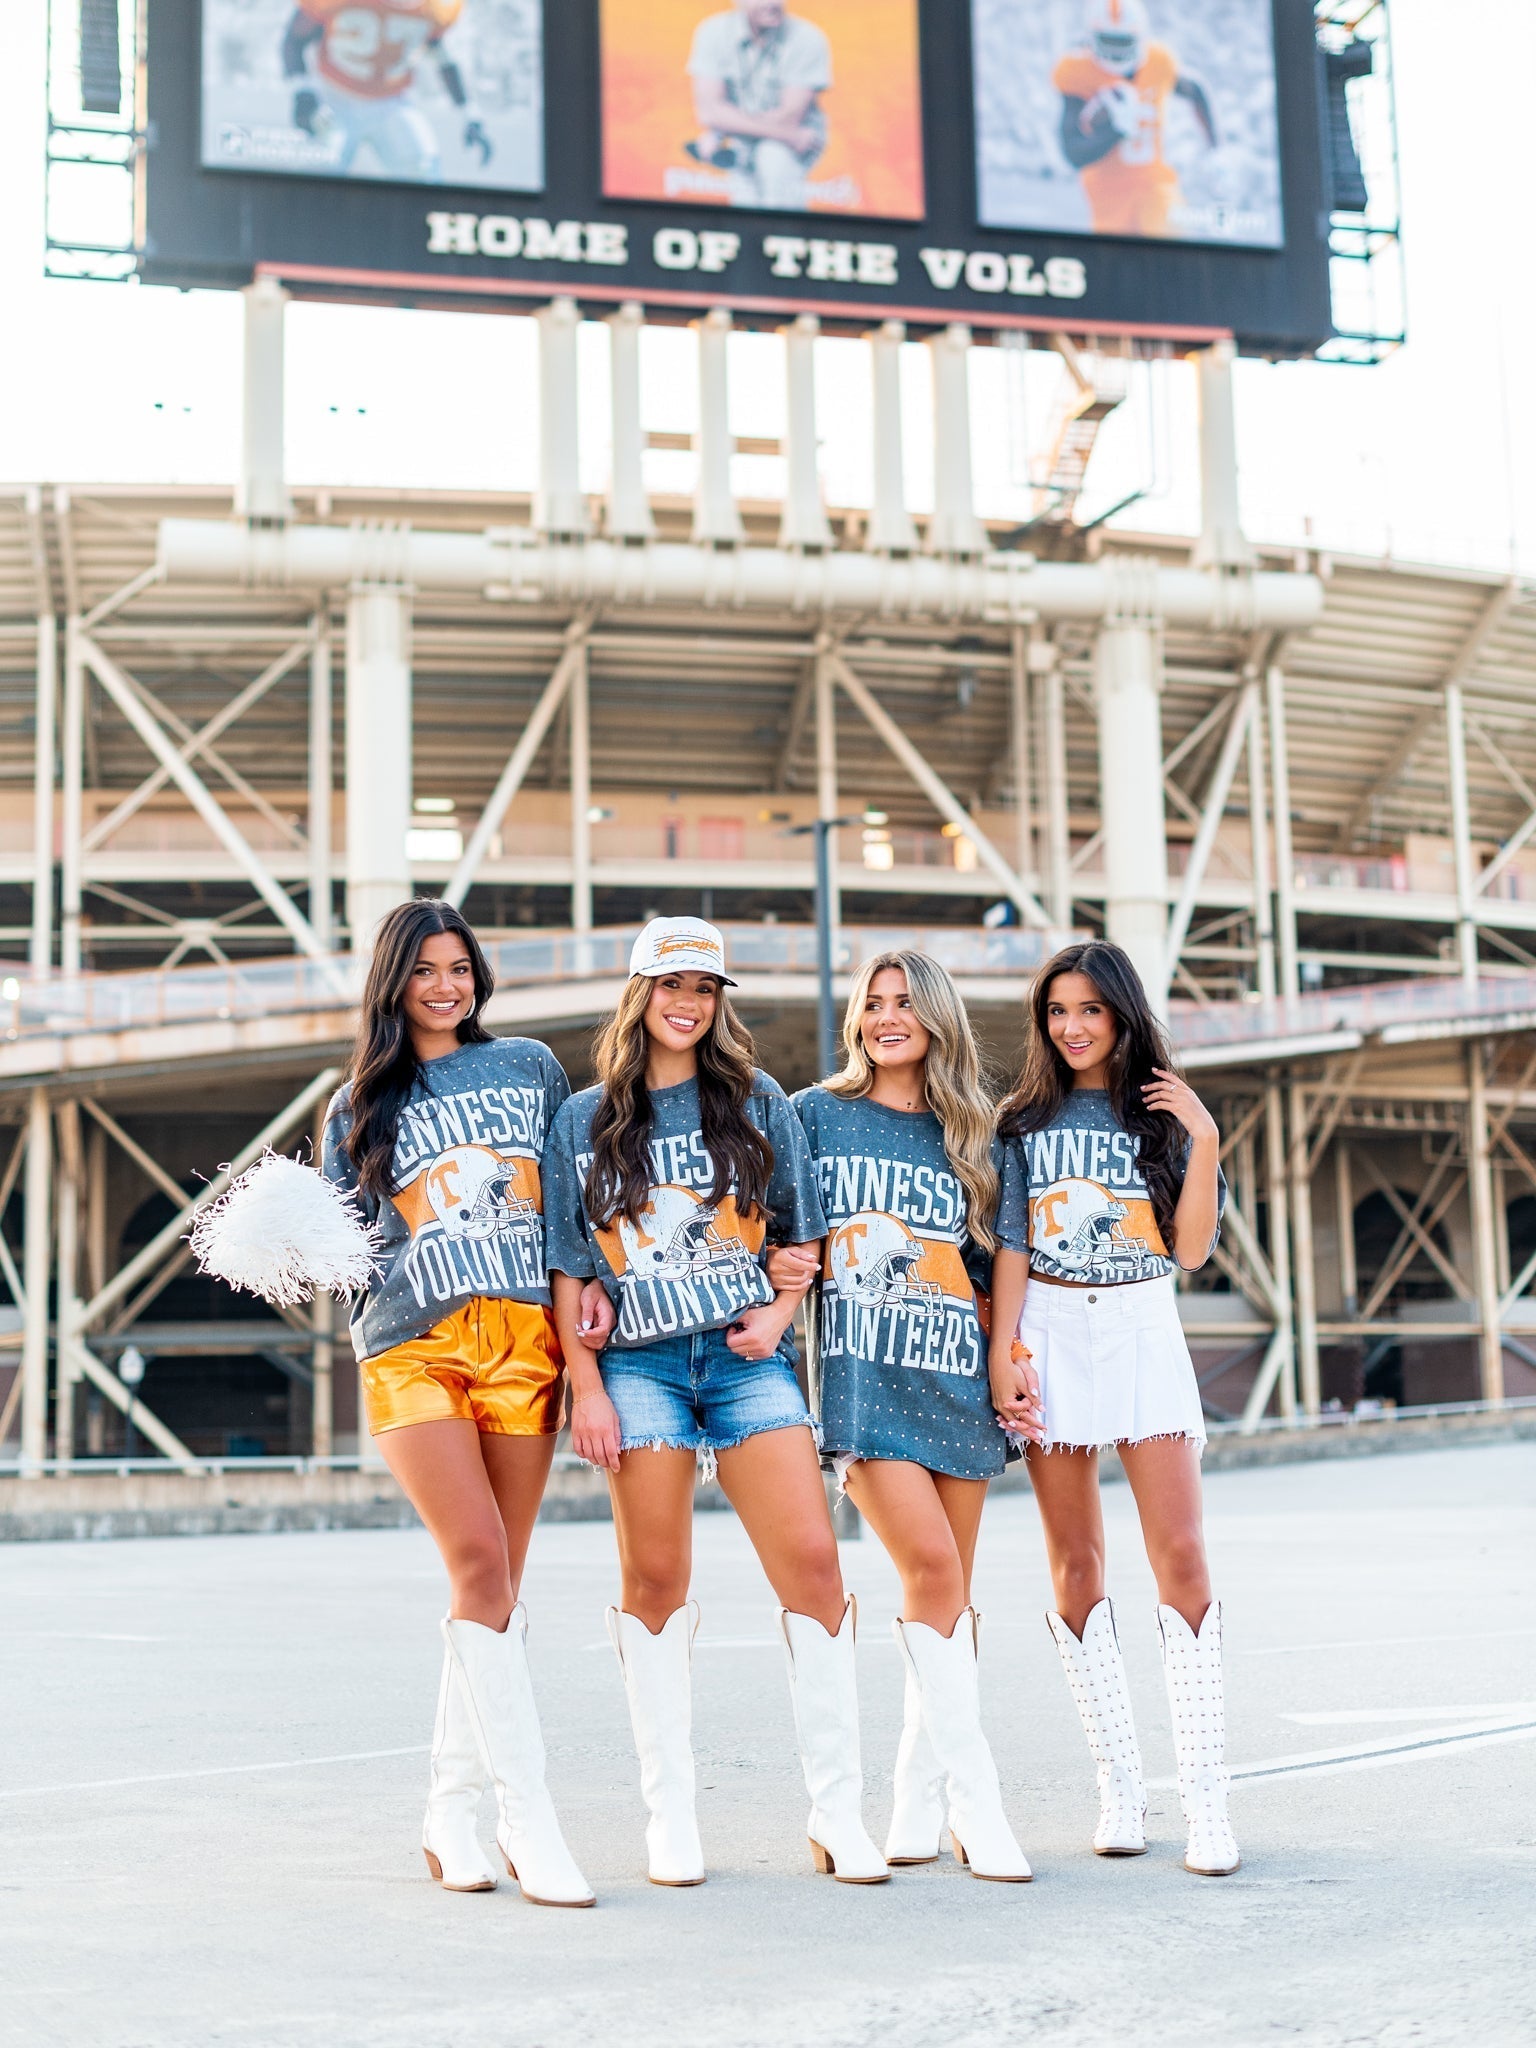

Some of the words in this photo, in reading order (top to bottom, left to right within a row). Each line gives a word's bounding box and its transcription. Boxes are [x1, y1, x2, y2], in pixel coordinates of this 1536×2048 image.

[427, 212, 628, 265] HOME
[653, 228, 740, 272] OF
[763, 235, 898, 285] THE
[919, 248, 1087, 299] VOLS
[430, 1160, 463, 1209] T
[1036, 1190, 1069, 1238] T
[835, 1223, 868, 1268] T
